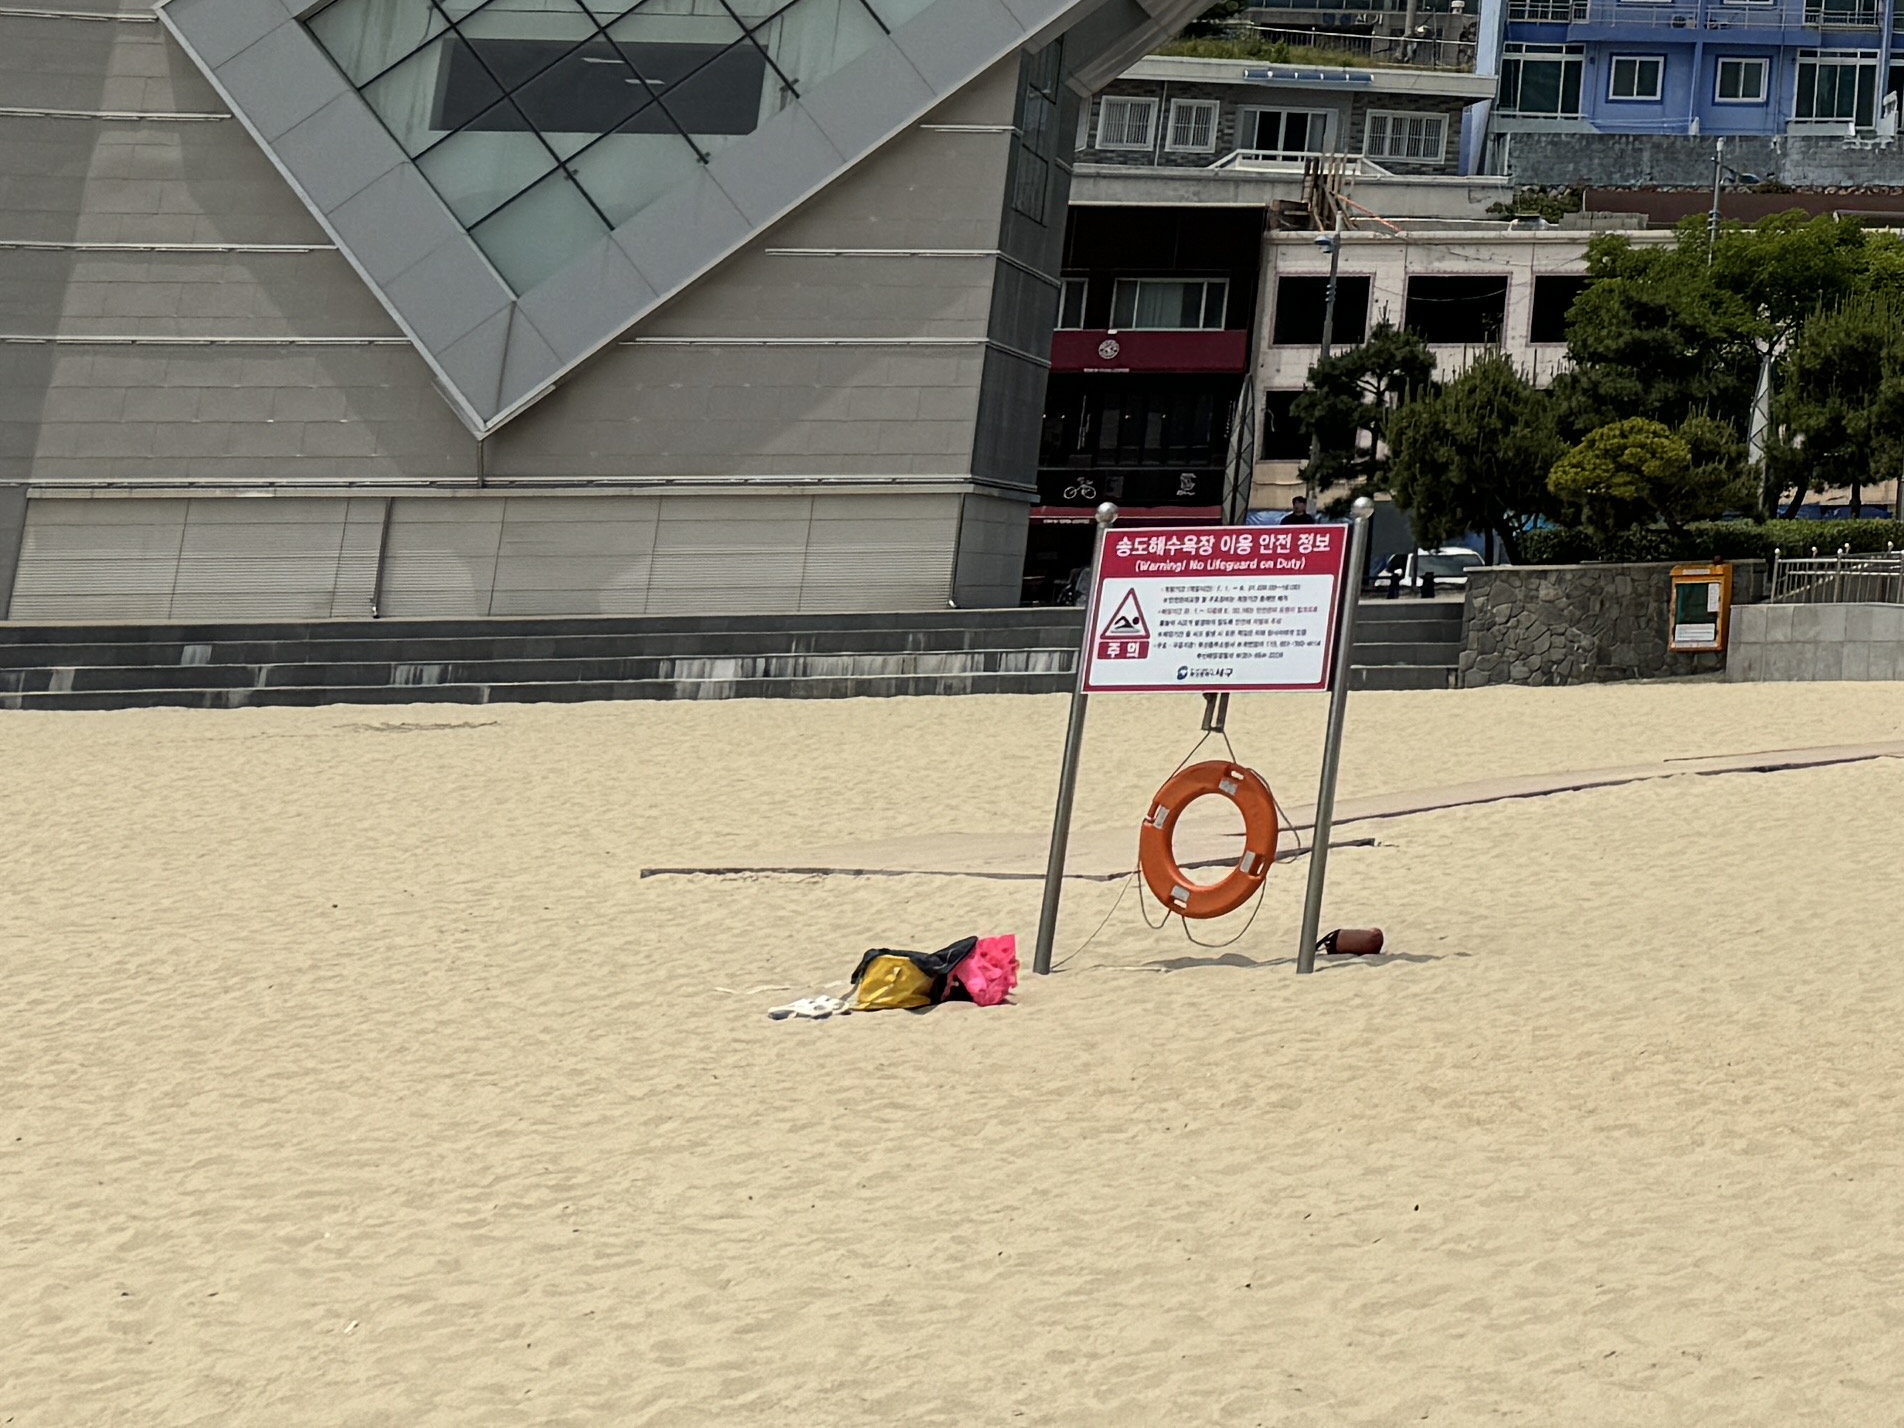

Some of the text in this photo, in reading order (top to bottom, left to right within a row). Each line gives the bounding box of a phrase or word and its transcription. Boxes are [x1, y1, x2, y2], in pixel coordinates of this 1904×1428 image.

[1116, 532, 1331, 557] 송도해수욕장 이용 안전 정보
[1135, 557, 1306, 573] (Warning! No Lifeguard on Duty)
